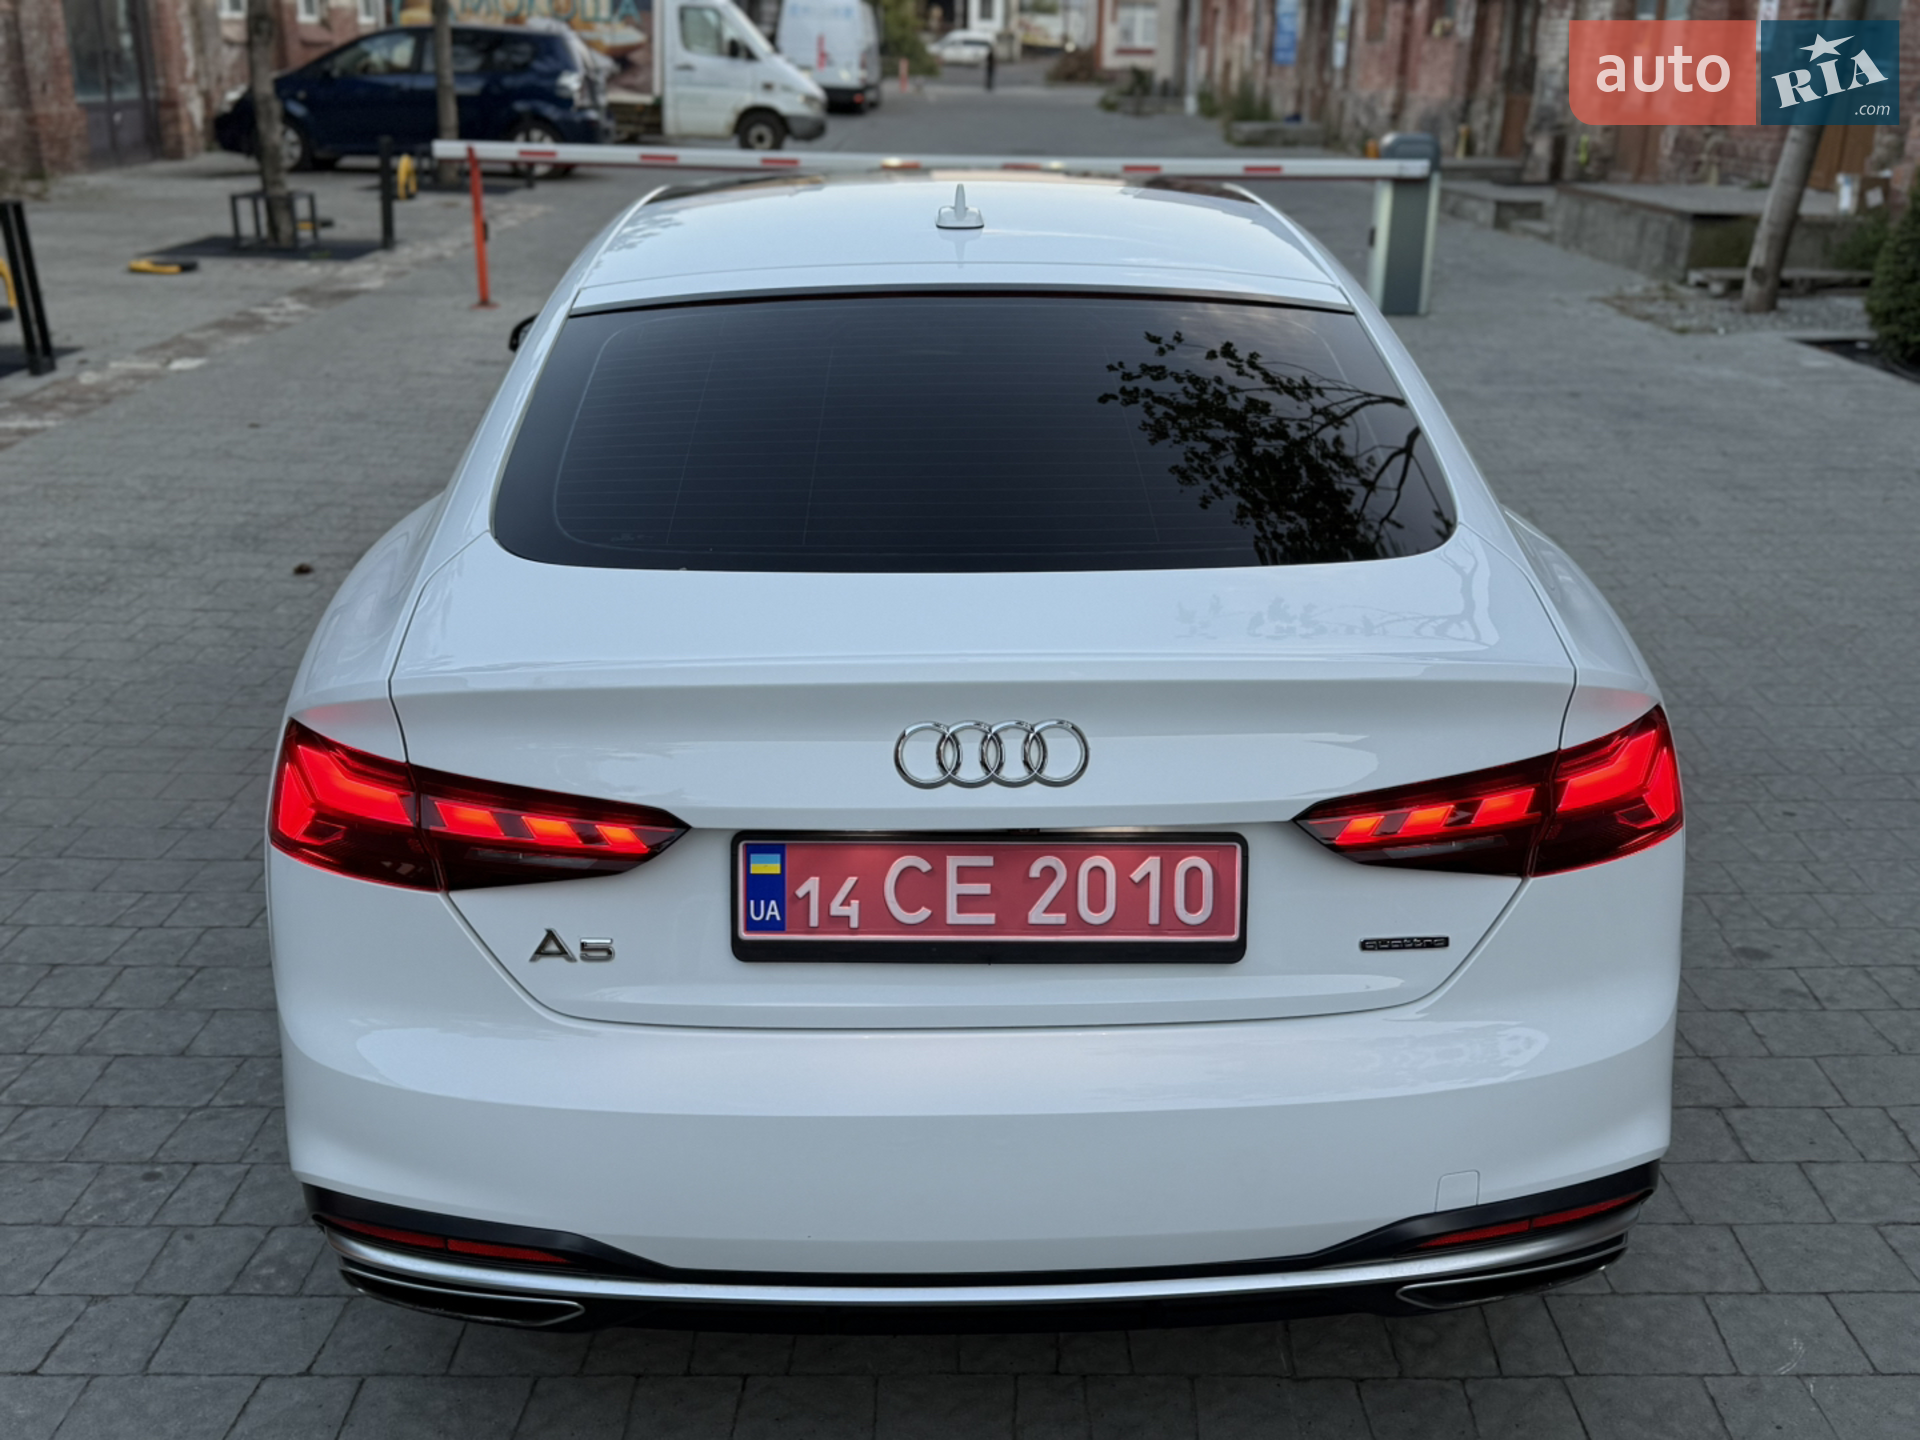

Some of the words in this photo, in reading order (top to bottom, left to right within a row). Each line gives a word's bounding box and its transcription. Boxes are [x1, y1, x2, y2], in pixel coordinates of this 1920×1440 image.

[795, 876, 860, 929] 14
[883, 855, 996, 925] CE
[1027, 855, 1214, 926] 2010
[750, 900, 781, 921] UA
[528, 928, 615, 963] A5
[1364, 938, 1446, 950] quattro
